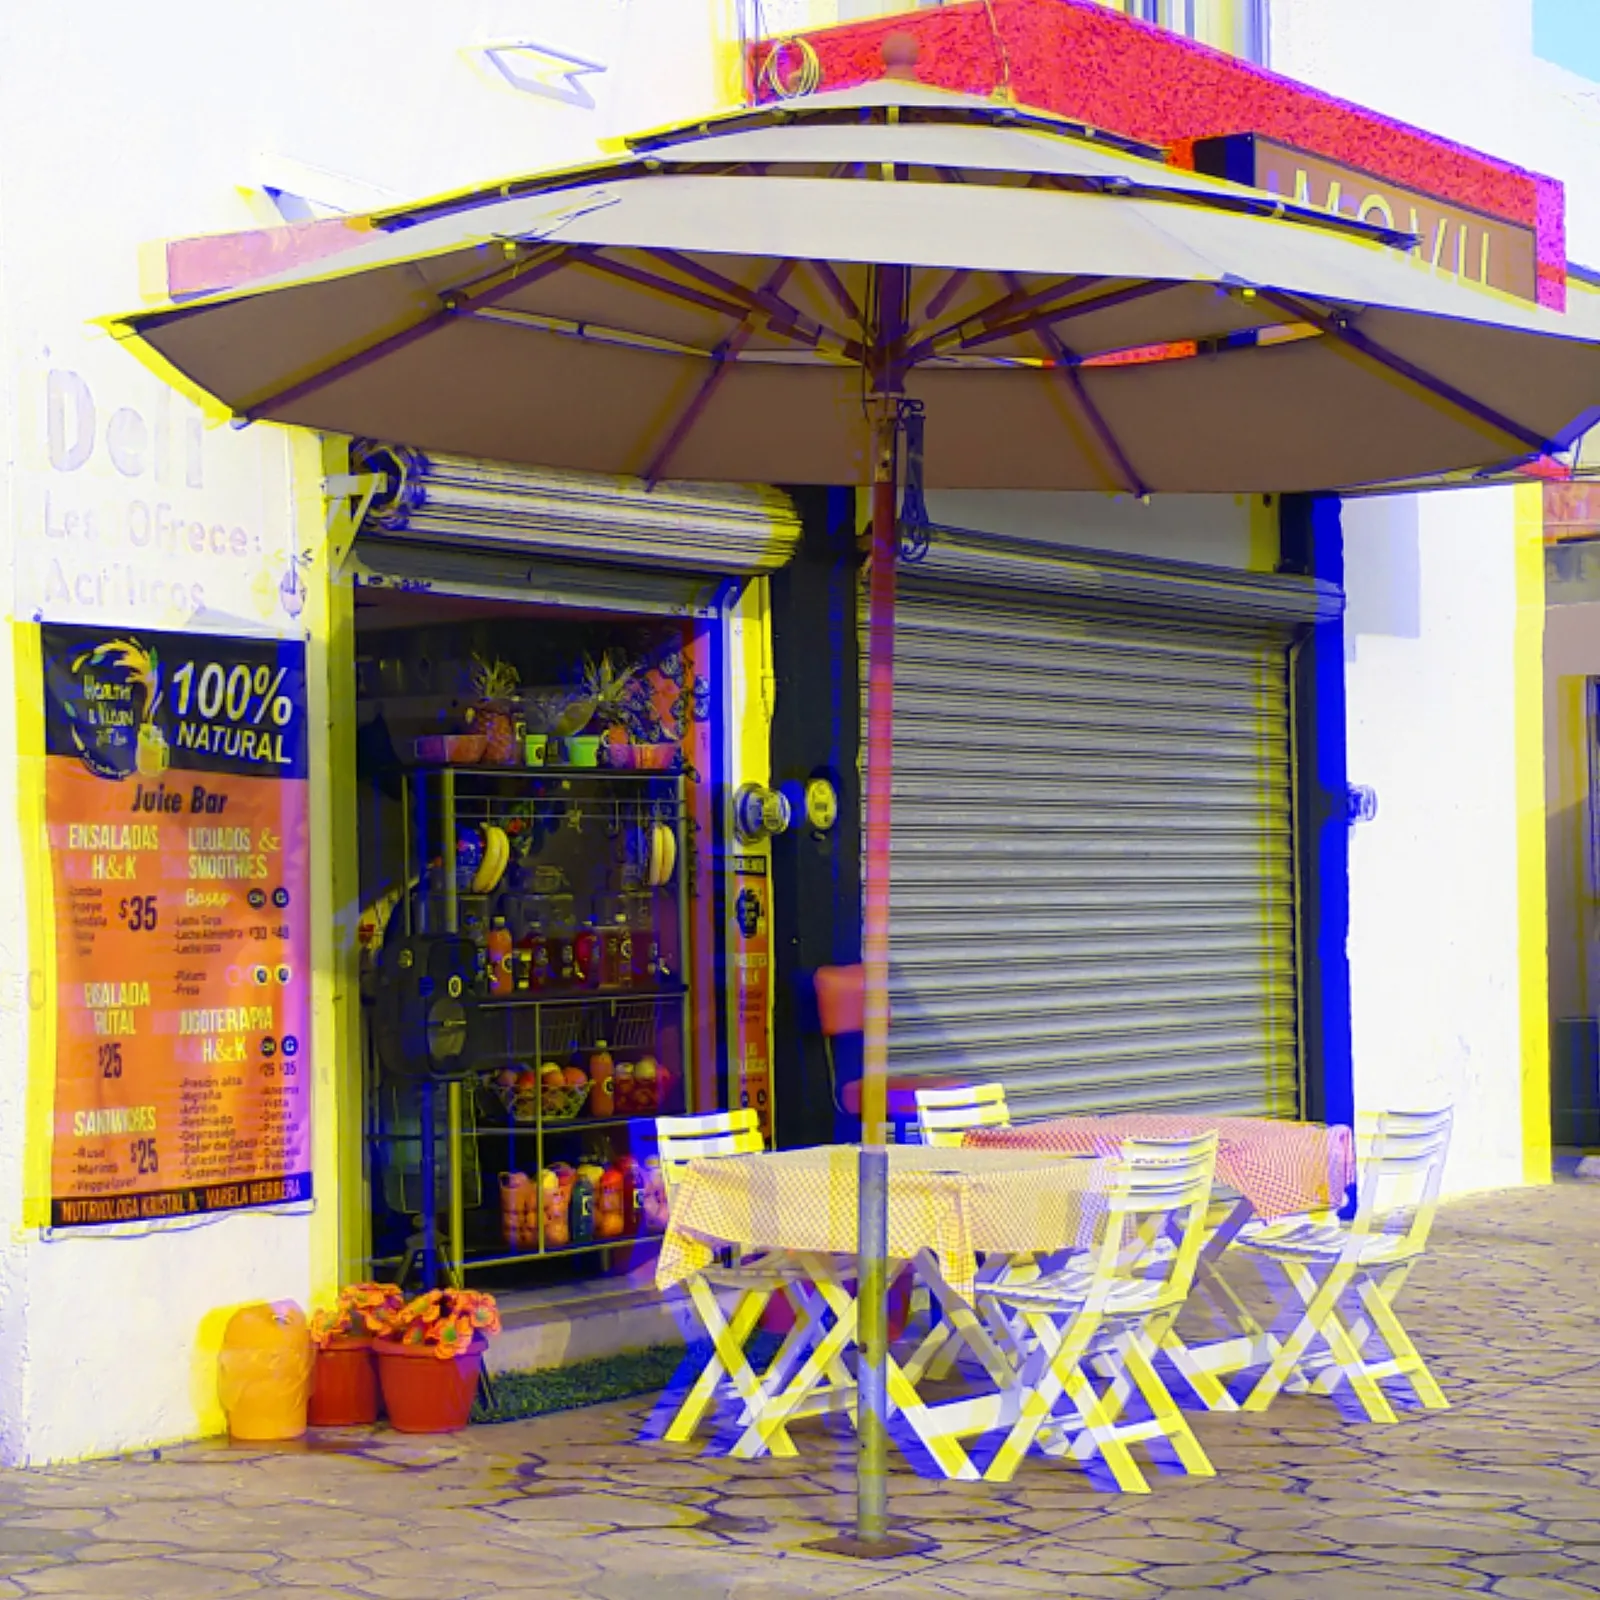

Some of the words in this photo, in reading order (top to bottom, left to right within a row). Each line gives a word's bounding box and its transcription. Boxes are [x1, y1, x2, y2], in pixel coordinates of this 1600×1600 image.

[173, 661, 293, 726] 100%
[177, 721, 292, 764] NATURAL
[132, 784, 182, 813] Juice
[191, 786, 228, 814] Bar
[69, 823, 158, 851] ENSALADAS
[188, 827, 250, 852] LICUADOS
[259, 827, 281, 853] &
[188, 854, 268, 880] SMOOTHIES
[118, 895, 158, 931] $35
[179, 1006, 273, 1035] JUGOTERAPIA
[130, 1138, 159, 1173] $25
